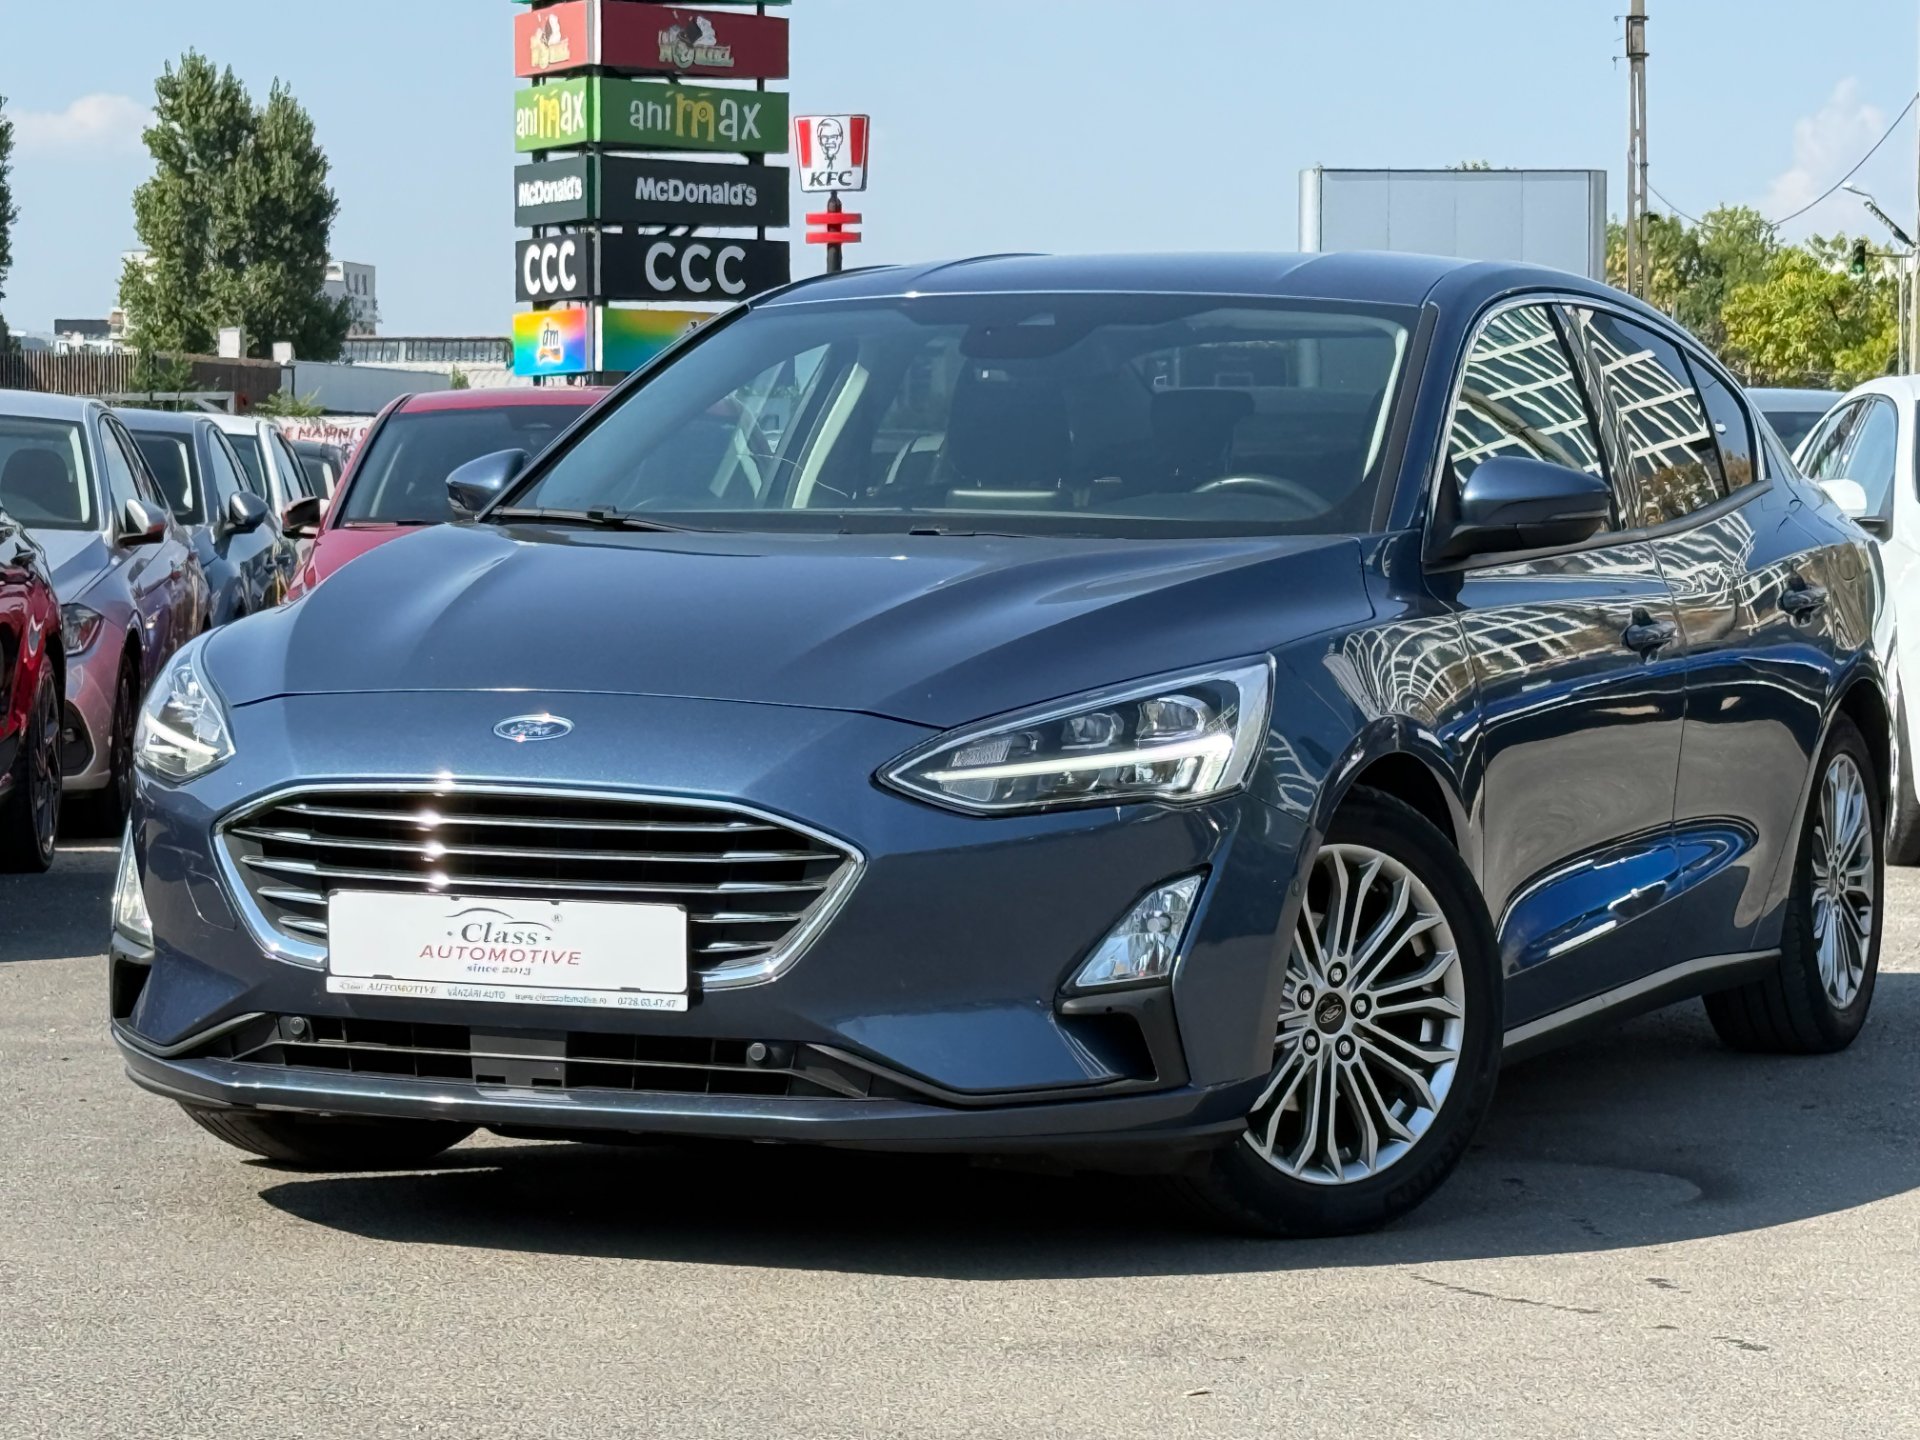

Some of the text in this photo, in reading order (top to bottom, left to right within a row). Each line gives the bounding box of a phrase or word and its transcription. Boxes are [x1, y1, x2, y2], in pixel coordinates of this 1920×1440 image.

[516, 89, 585, 139] animax
[629, 91, 761, 142] animax
[518, 176, 583, 208] McDonald's
[635, 177, 757, 207] McDonald's
[809, 170, 853, 188] KFC
[524, 240, 577, 295] CCC
[645, 242, 747, 294] CCC
[543, 323, 559, 346] dm
[461, 922, 538, 945] Class
[419, 944, 581, 966] AUTOMOTIVE
[466, 963, 498, 974] since
